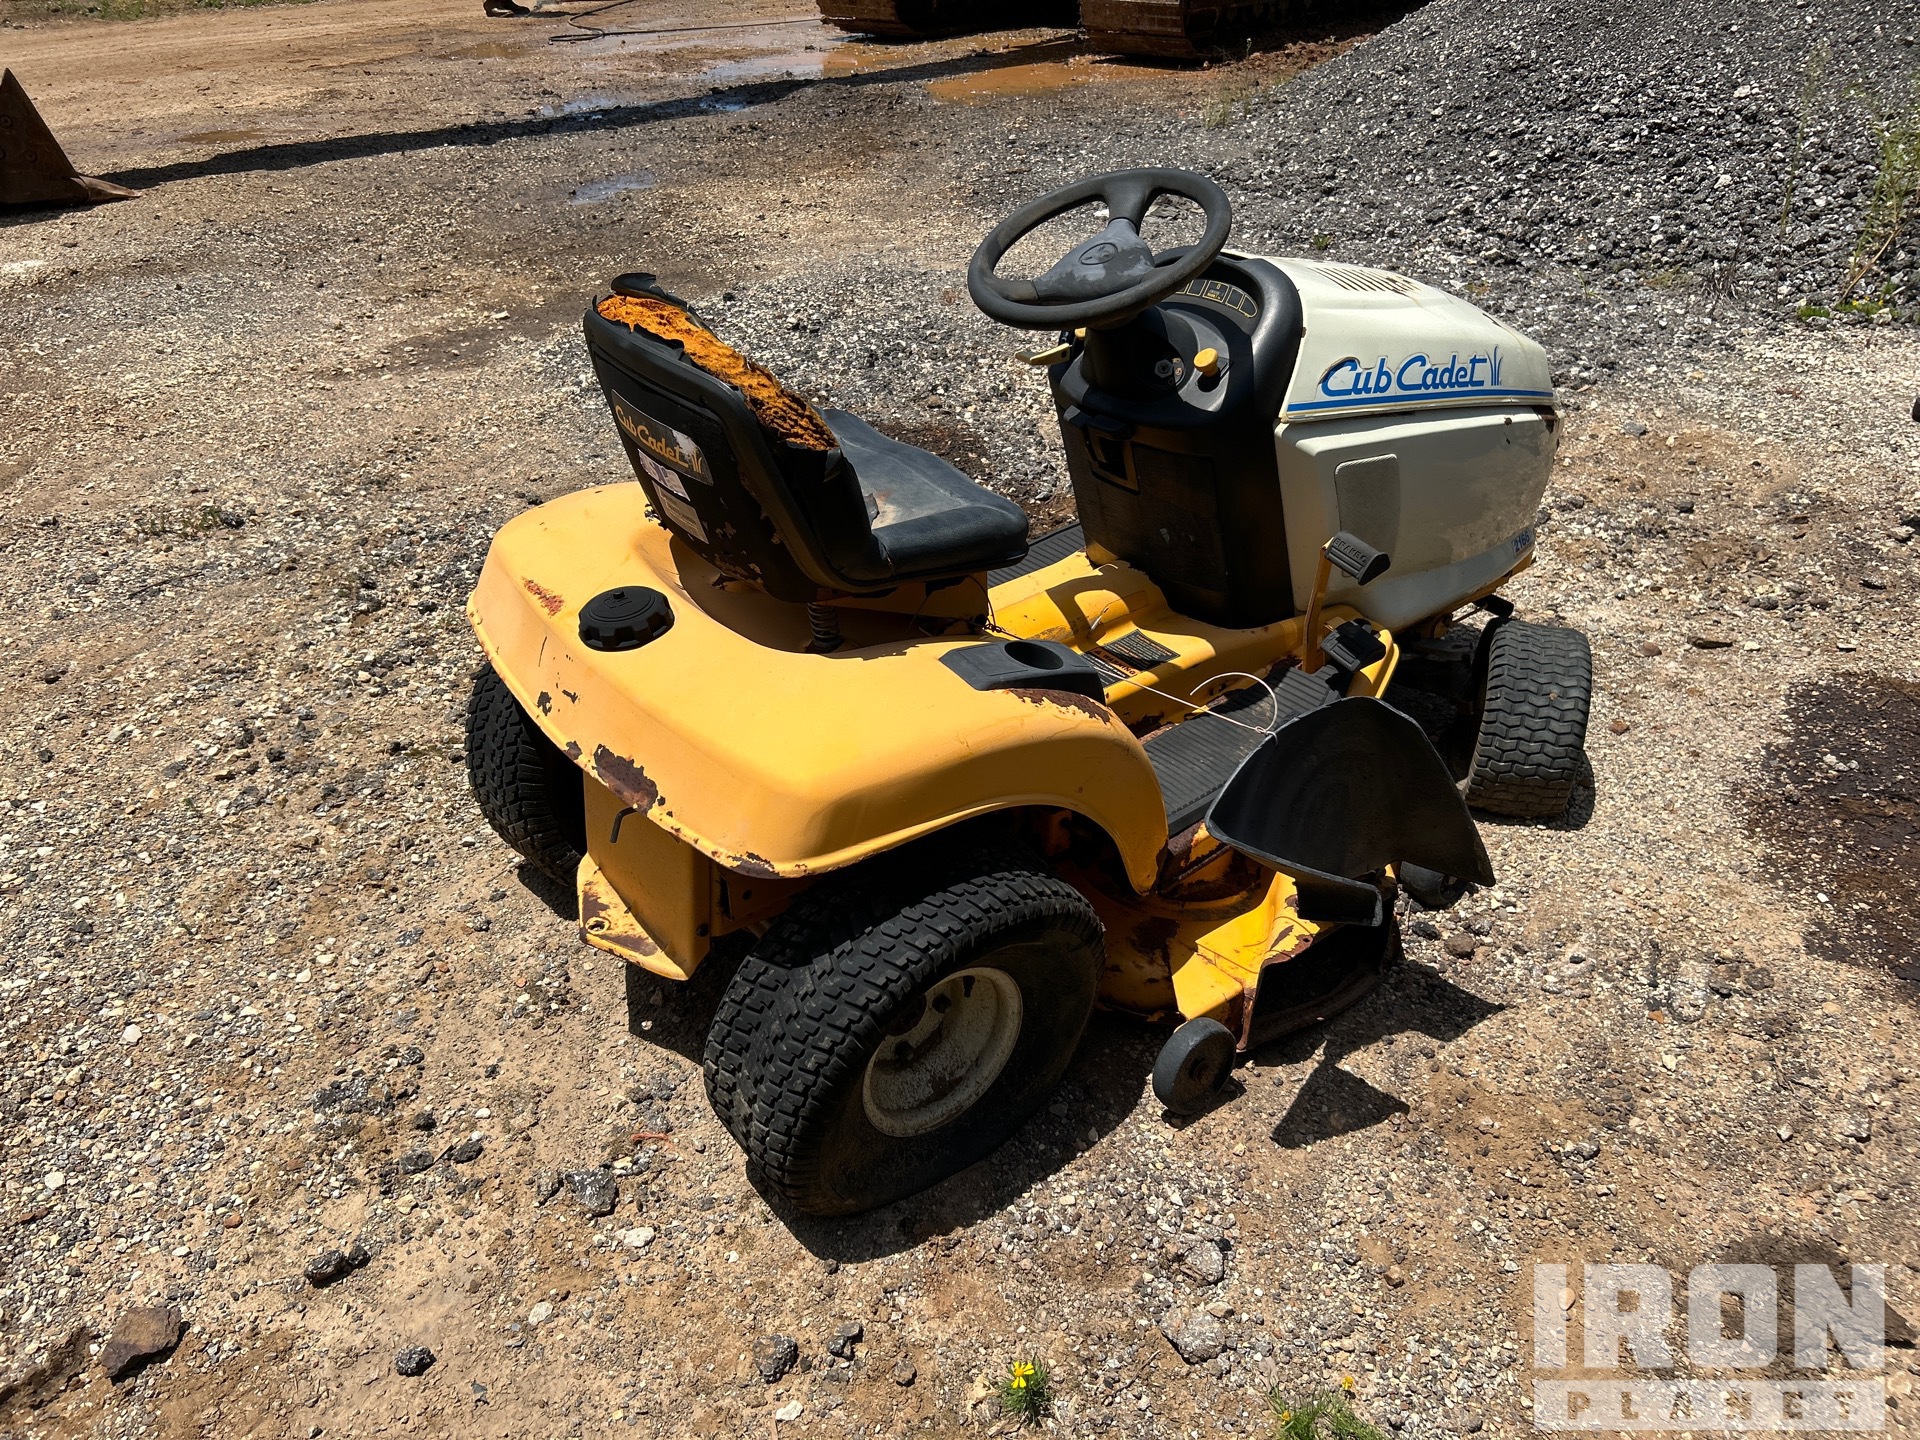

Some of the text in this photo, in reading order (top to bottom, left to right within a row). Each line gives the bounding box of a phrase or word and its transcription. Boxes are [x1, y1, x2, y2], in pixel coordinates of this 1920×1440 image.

[1321, 354, 1487, 397] Cub Cadet
[615, 405, 689, 470] Cub Cadet
[1513, 530, 1530, 553] 2166
